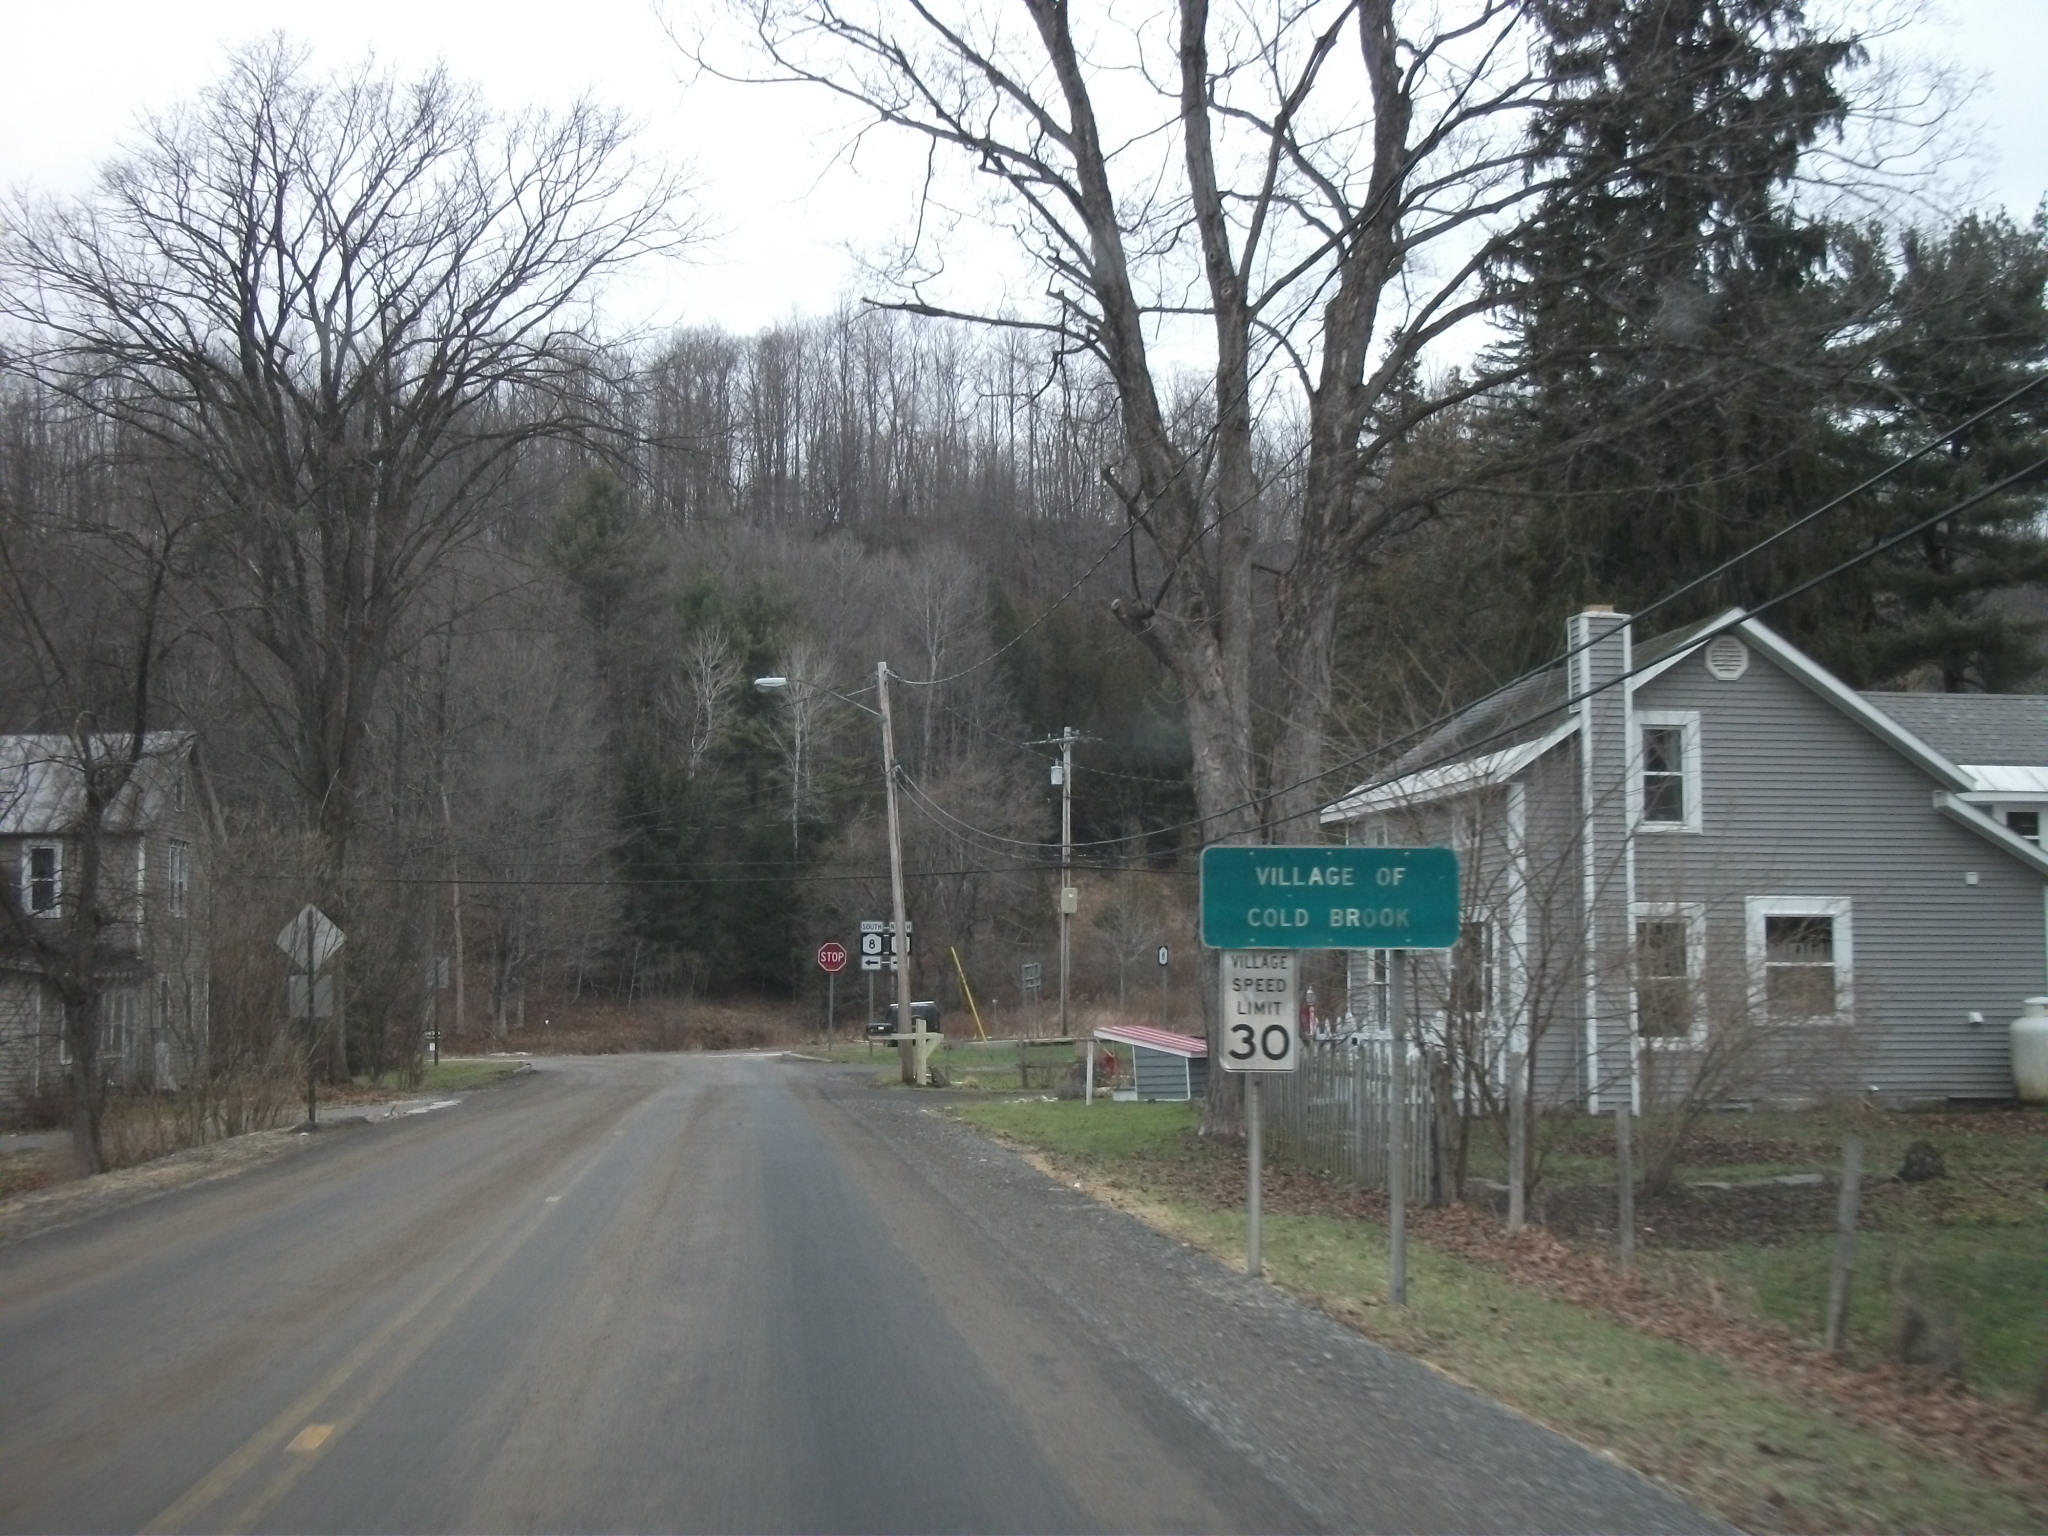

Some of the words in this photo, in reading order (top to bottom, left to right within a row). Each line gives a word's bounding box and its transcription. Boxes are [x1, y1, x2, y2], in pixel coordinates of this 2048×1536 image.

[1255, 867, 1355, 886] VILLAGE
[1375, 867, 1406, 886] OF
[1247, 908, 1309, 927] COLD
[1329, 908, 1411, 927] BROOK
[869, 939, 876, 949] 8
[820, 952, 844, 962] STOP
[1231, 955, 1288, 970] VILLAGE
[1232, 978, 1287, 993] SPEED
[1237, 1001, 1283, 1015] LIMIT
[1229, 1023, 1290, 1061] 30
